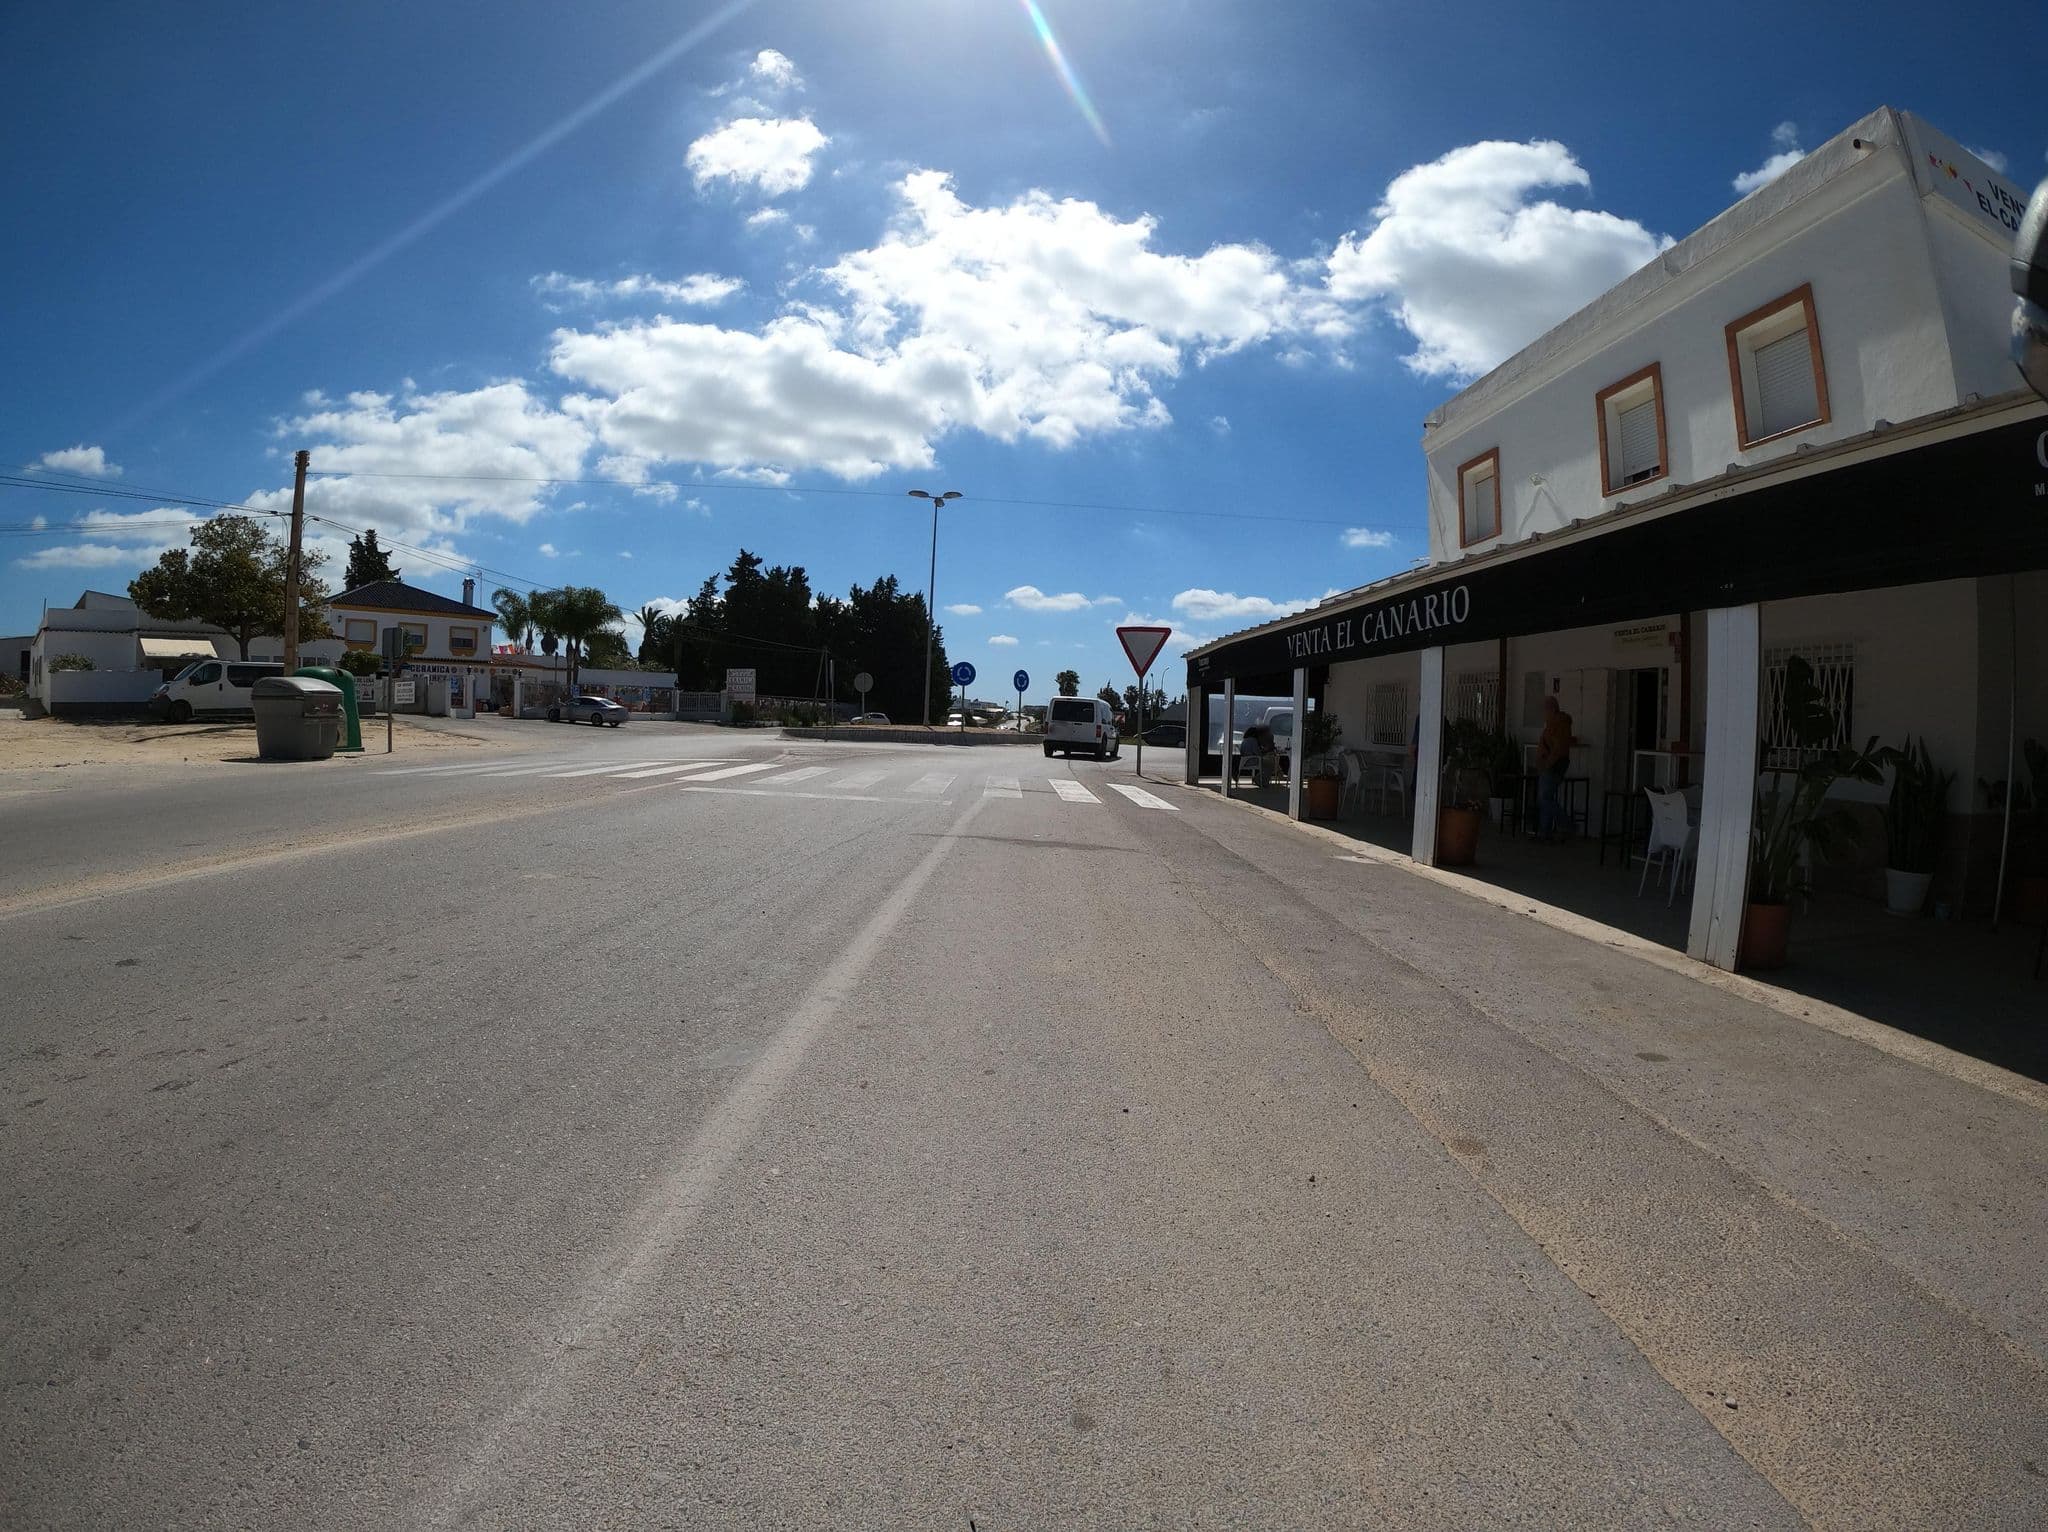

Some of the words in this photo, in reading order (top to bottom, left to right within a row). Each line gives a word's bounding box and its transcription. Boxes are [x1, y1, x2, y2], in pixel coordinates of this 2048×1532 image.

[1976, 191, 1999, 220] EL
[1286, 624, 1332, 659] VENTA
[1336, 619, 1355, 650] EL
[1361, 585, 1470, 644] CANARIO
